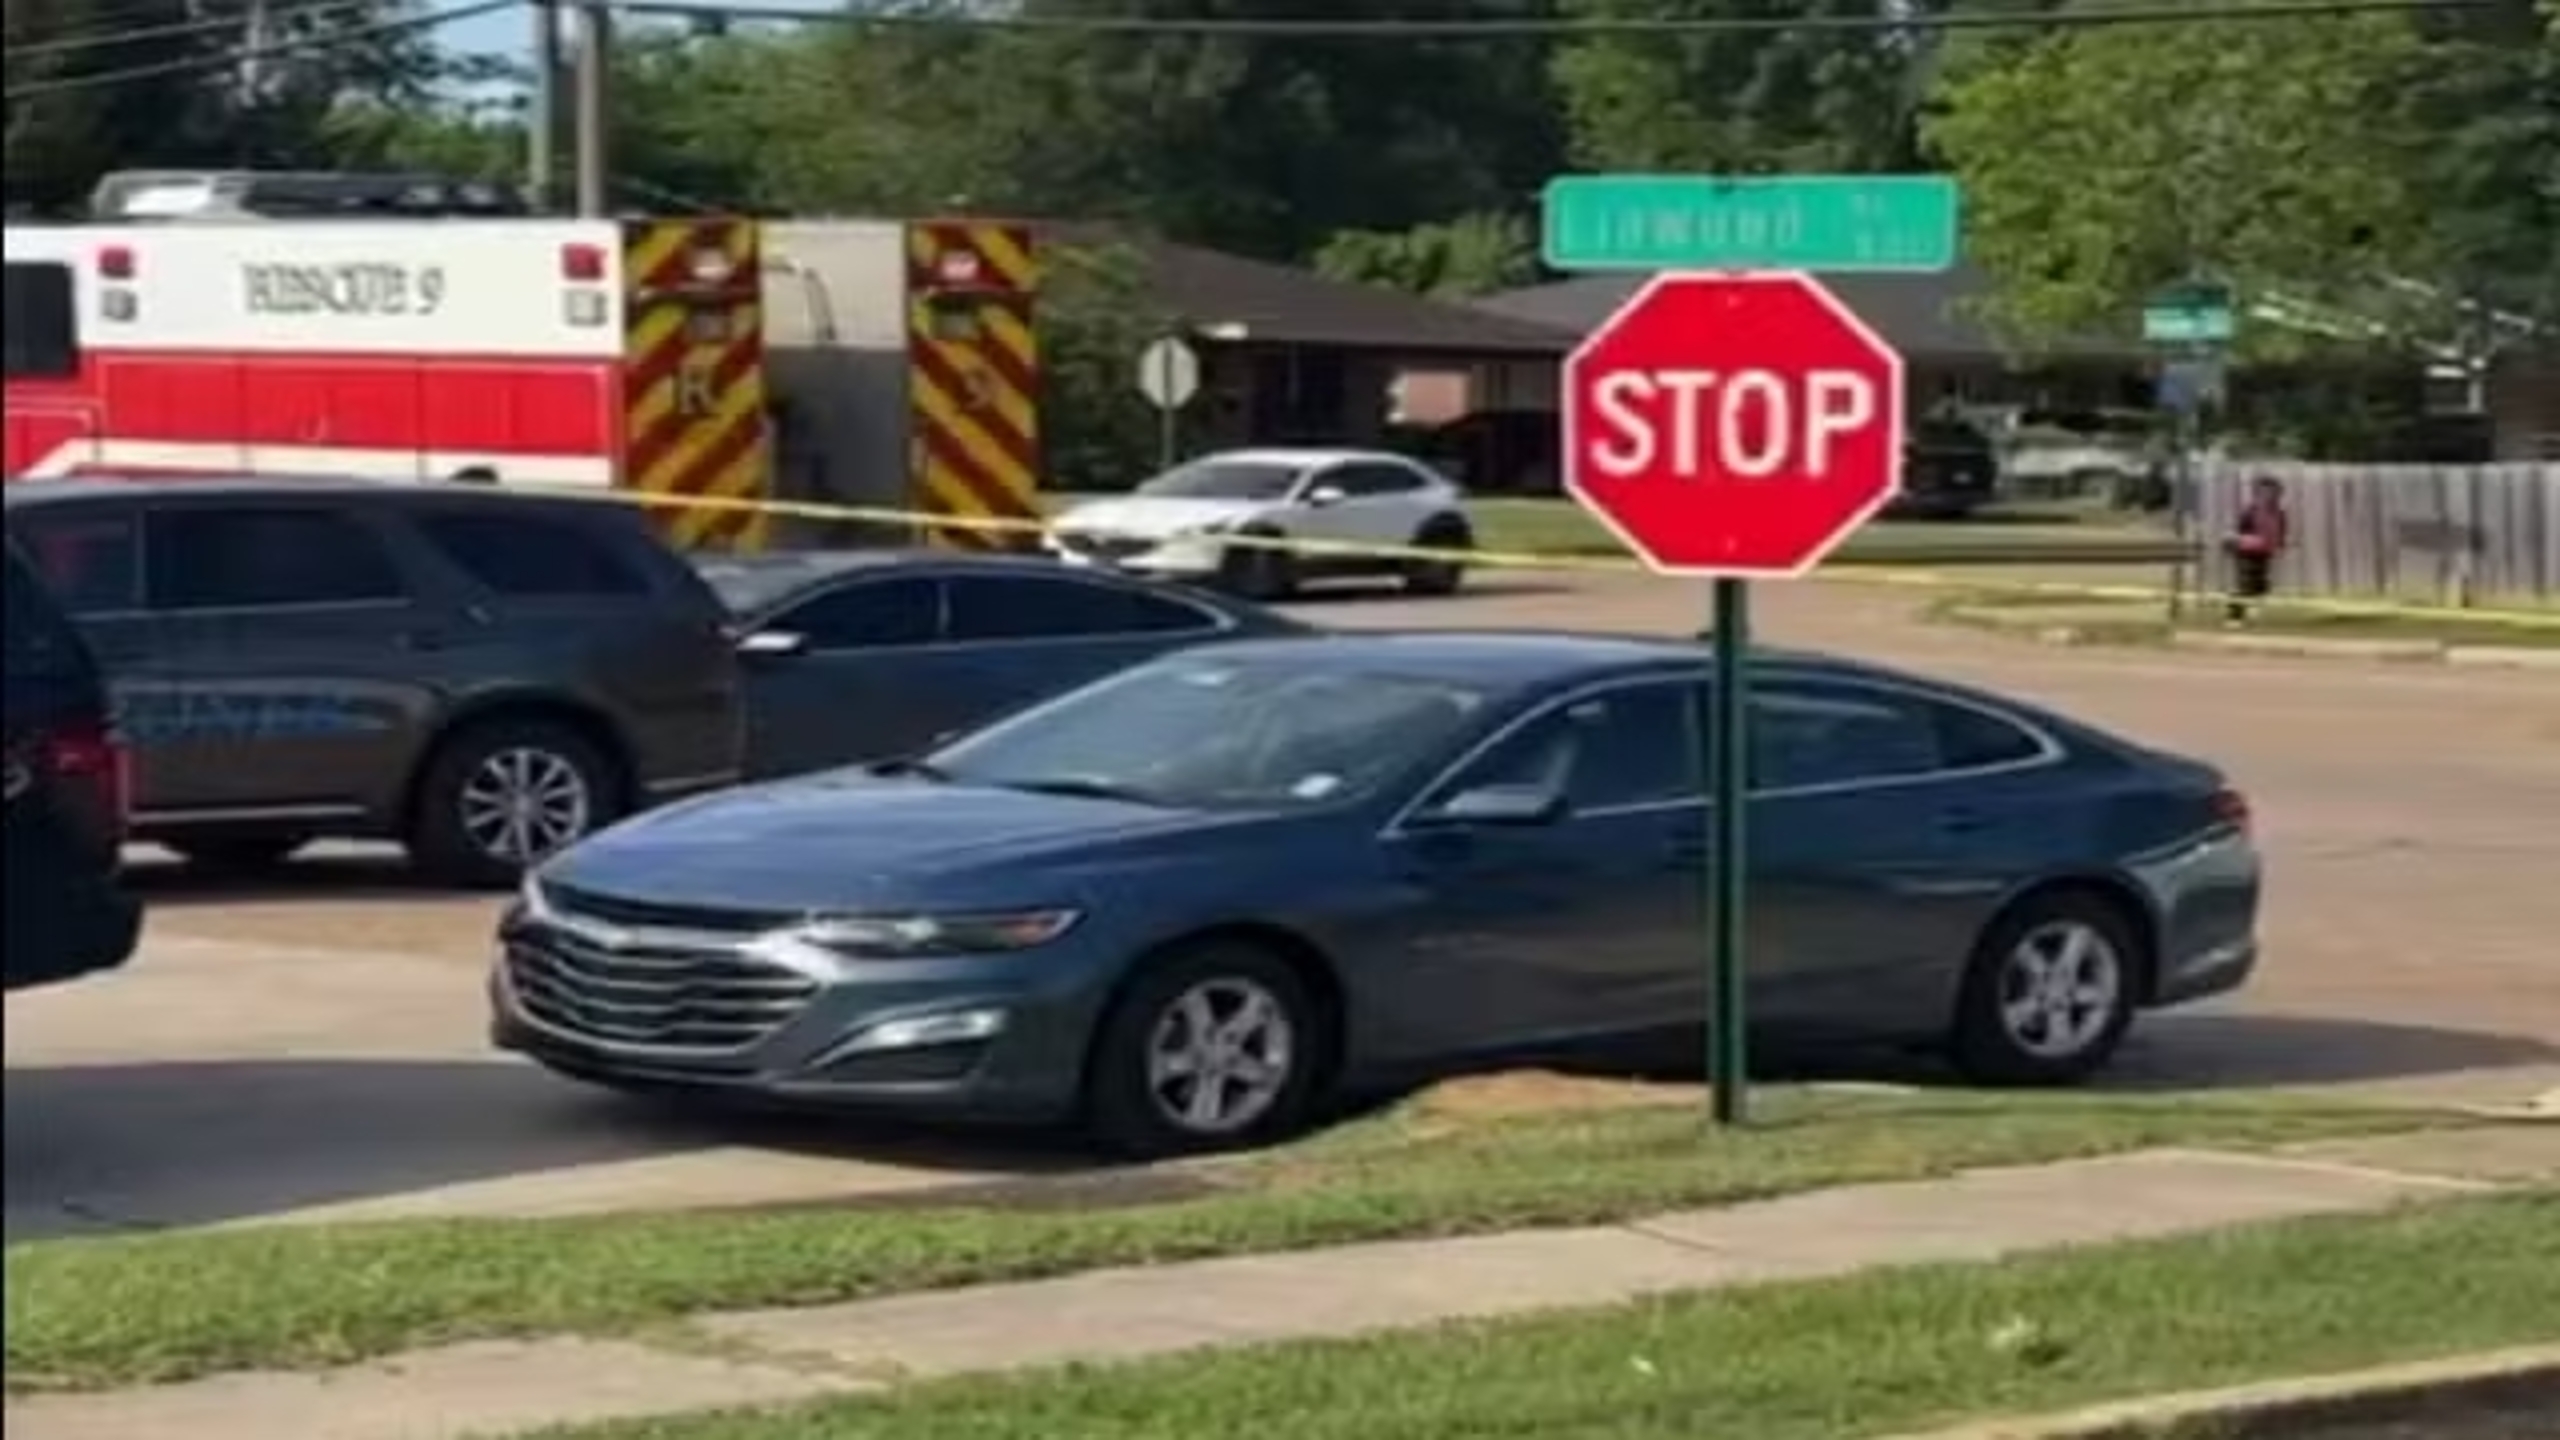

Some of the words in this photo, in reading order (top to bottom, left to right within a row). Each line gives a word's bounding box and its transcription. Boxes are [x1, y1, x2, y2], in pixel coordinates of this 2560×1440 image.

[241, 261, 406, 314] RESCUE
[416, 265, 445, 315] 9
[1590, 369, 1874, 477] STOP
